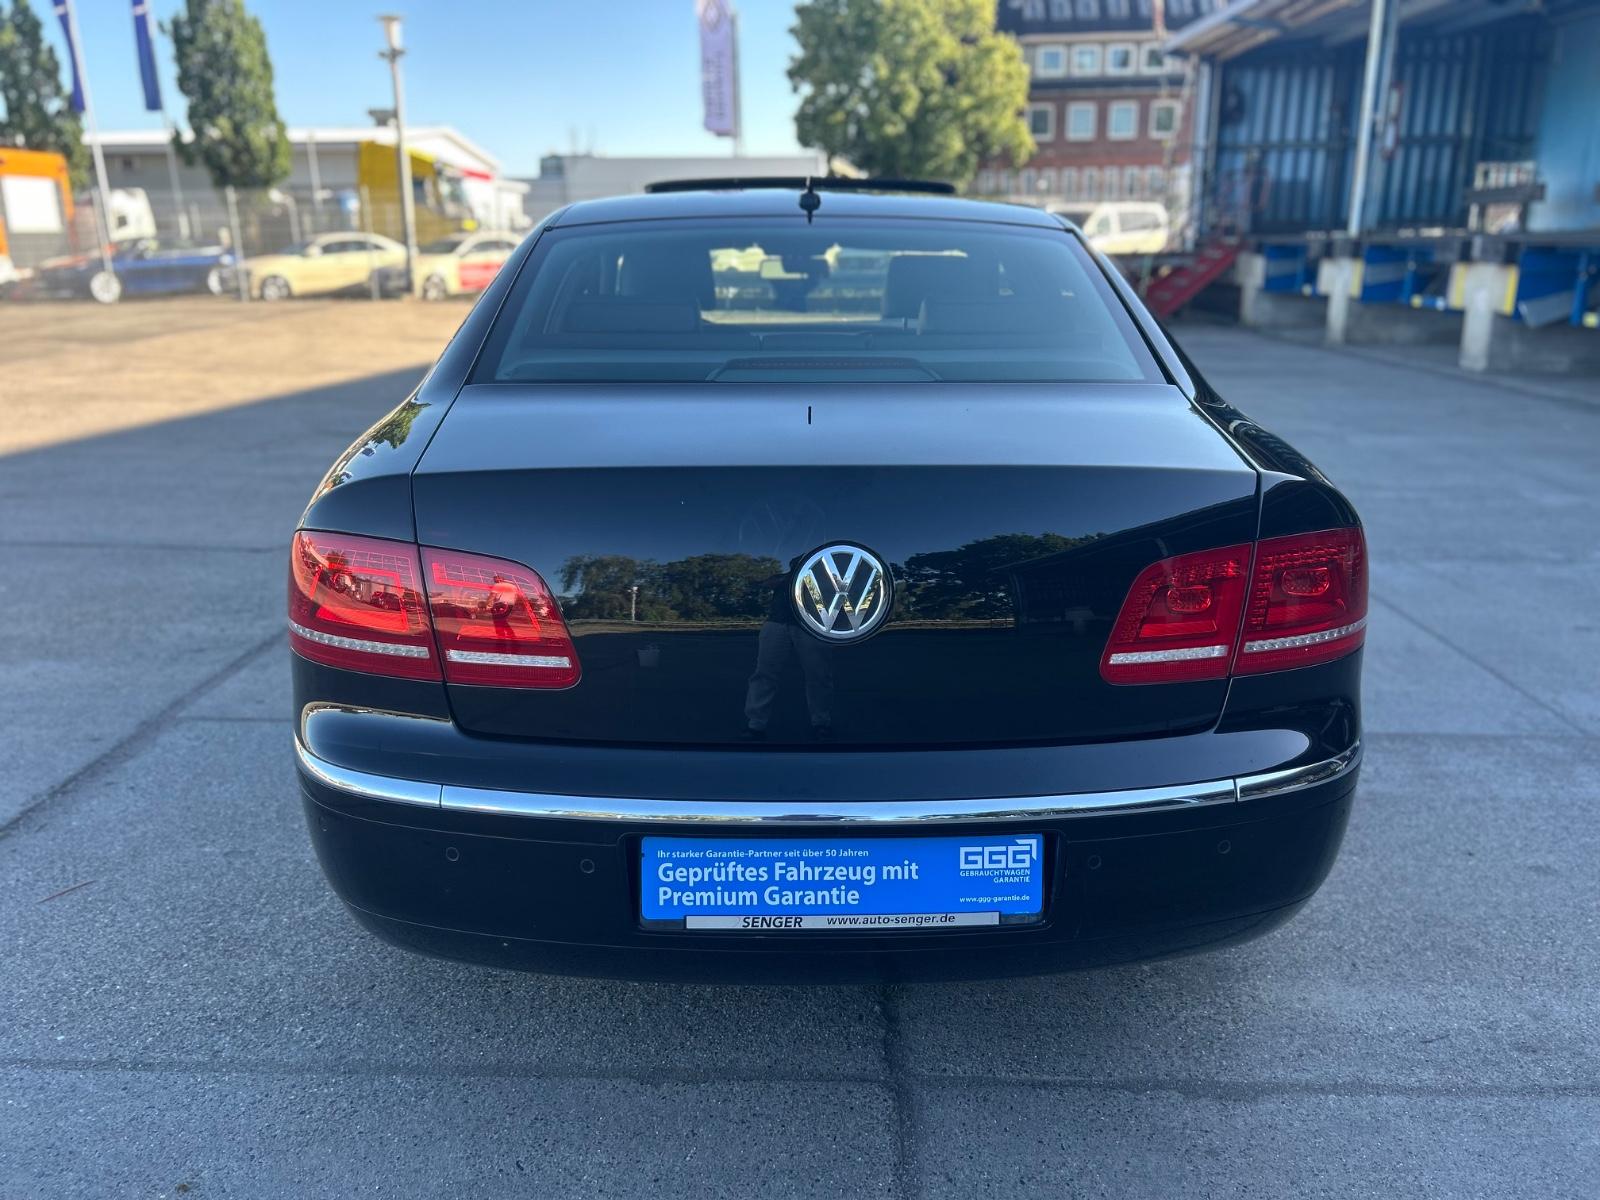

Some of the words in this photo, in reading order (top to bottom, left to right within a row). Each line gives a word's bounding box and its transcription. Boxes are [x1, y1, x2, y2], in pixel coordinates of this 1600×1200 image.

[657, 850, 671, 858] Ihr
[672, 850, 704, 858] starker
[705, 849, 783, 858] Garantie-Partner
[784, 849, 800, 858] seit
[802, 849, 824, 858] über
[825, 849, 837, 857] 50
[838, 848, 869, 857] Jahren
[960, 845, 1031, 869] GGG
[657, 861, 769, 887] Geprüftes
[774, 860, 876, 886] Fahrzeug
[882, 860, 919, 880] mit
[960, 869, 1031, 877] GEBRAUCHTWAGEN
[658, 886, 758, 906] Premium
[764, 885, 860, 906] Garantie
[960, 895, 1031, 903] www.ggg-garantie.de
[742, 916, 803, 928] SENGER
[827, 914, 956, 927] www.auto-senger.de
